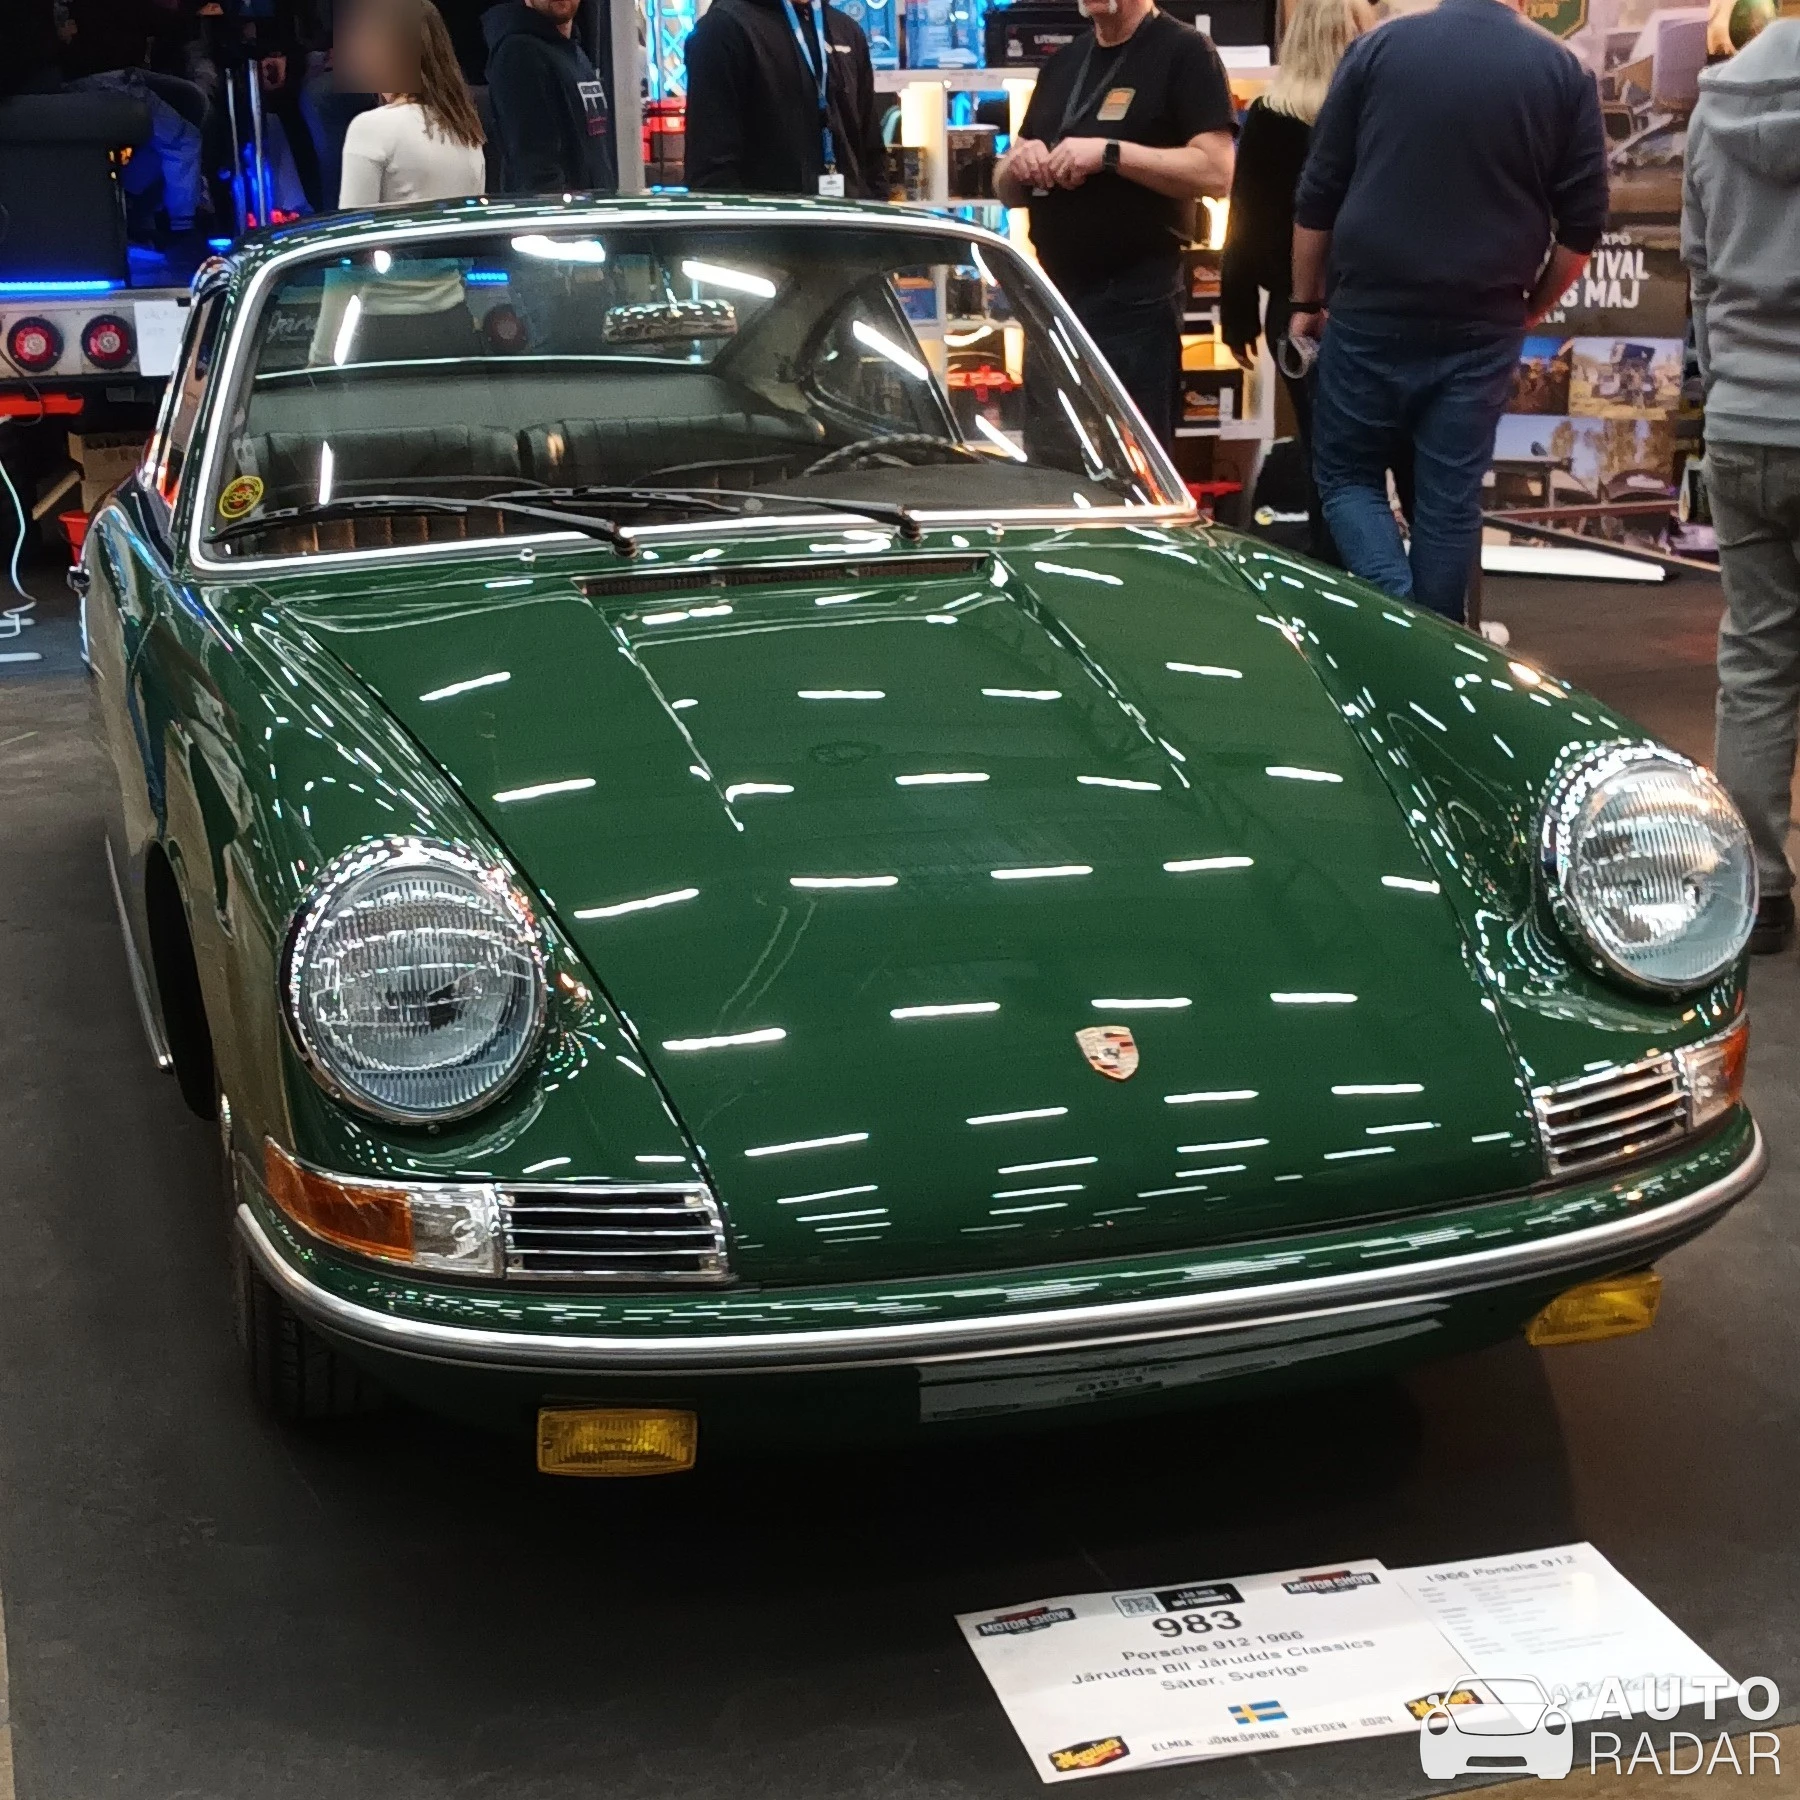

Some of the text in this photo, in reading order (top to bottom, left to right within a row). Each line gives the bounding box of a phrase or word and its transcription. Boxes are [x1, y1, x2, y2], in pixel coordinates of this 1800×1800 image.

[1583, 249, 1651, 280] TIVAL
[1584, 279, 1640, 309] MAJ
[1473, 1562, 1538, 1577] Porsche
[1286, 1578, 1337, 1593] MOTOR
[1333, 1574, 1375, 1587] SHOW
[981, 1618, 1030, 1635] MOTOR
[1028, 1610, 1070, 1626] SHOW
[1151, 1610, 1243, 1639] 983
[1121, 1630, 1305, 1661] Porsche 912 1966
[1286, 1639, 1376, 1657] Classics
[1227, 1665, 1309, 1682] Sverige
[1151, 1739, 1194, 1752] ELMIA
[1206, 1730, 1280, 1746] JÖNKÖPING
[1291, 1721, 1348, 1736] SWEDEN
